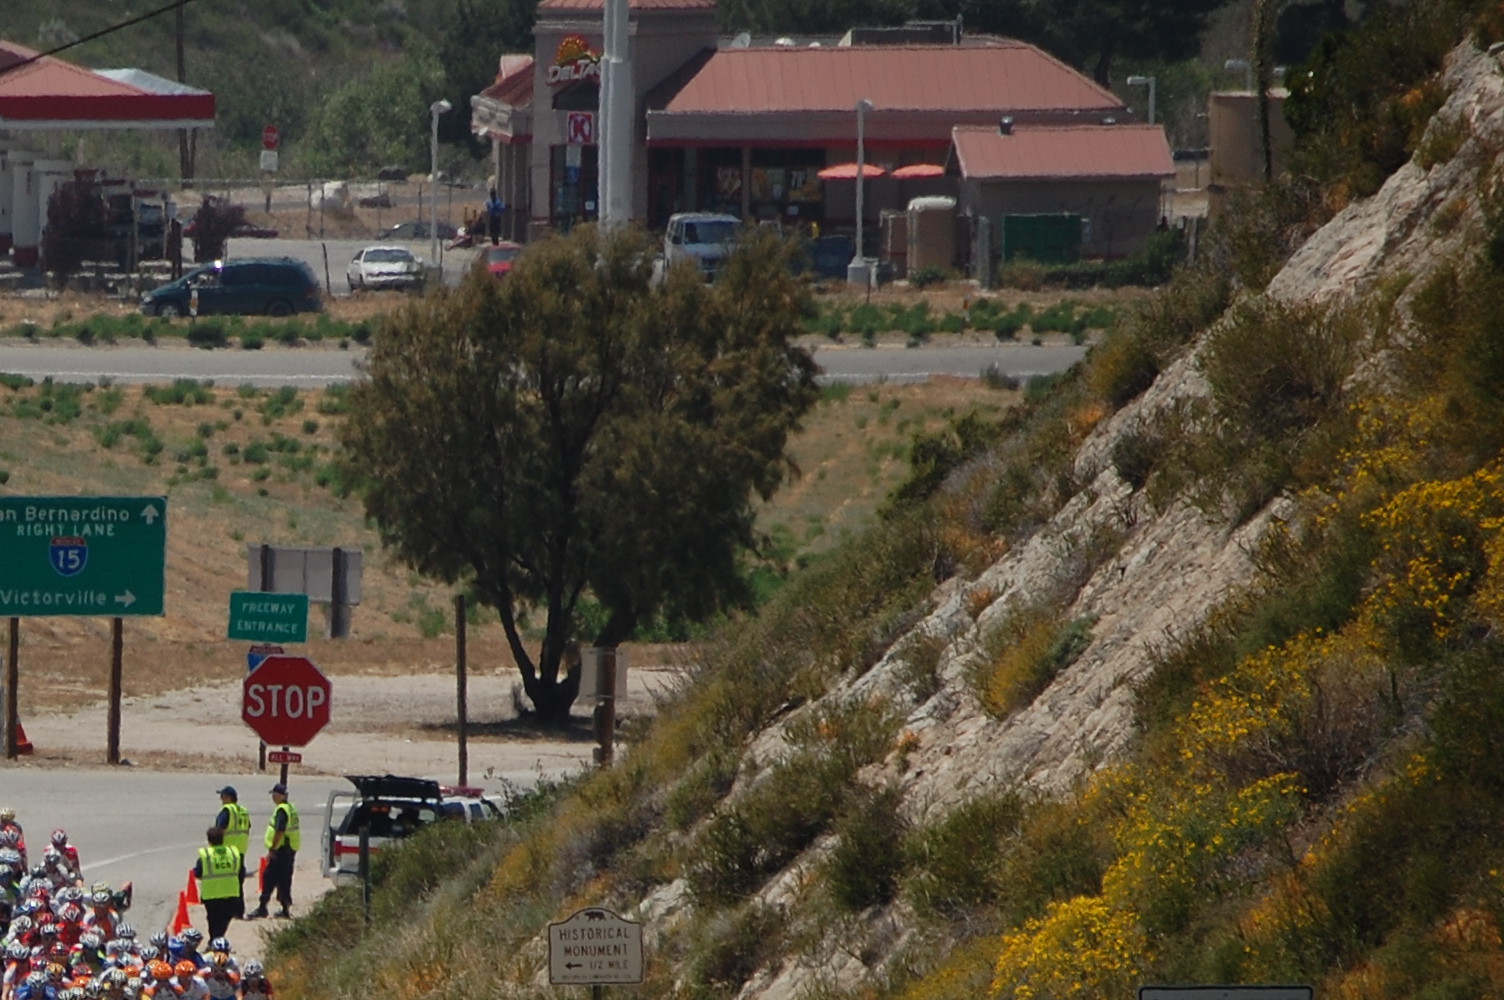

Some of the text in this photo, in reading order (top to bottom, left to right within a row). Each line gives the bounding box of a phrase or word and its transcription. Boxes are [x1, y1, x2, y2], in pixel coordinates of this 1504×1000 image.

[25, 506, 130, 522] Bernardino
[17, 523, 115, 536] RIGHT LANE
[58, 550, 80, 569] 15
[0, 589, 107, 605] Victorville
[242, 602, 295, 615] FREEWAY
[237, 620, 299, 634] ENTRANCE
[247, 684, 326, 719] STOP
[559, 927, 631, 941] HISTORICAL
[563, 943, 628, 957] MONUMENT
[590, 960, 628, 971] 1/2 MILE
